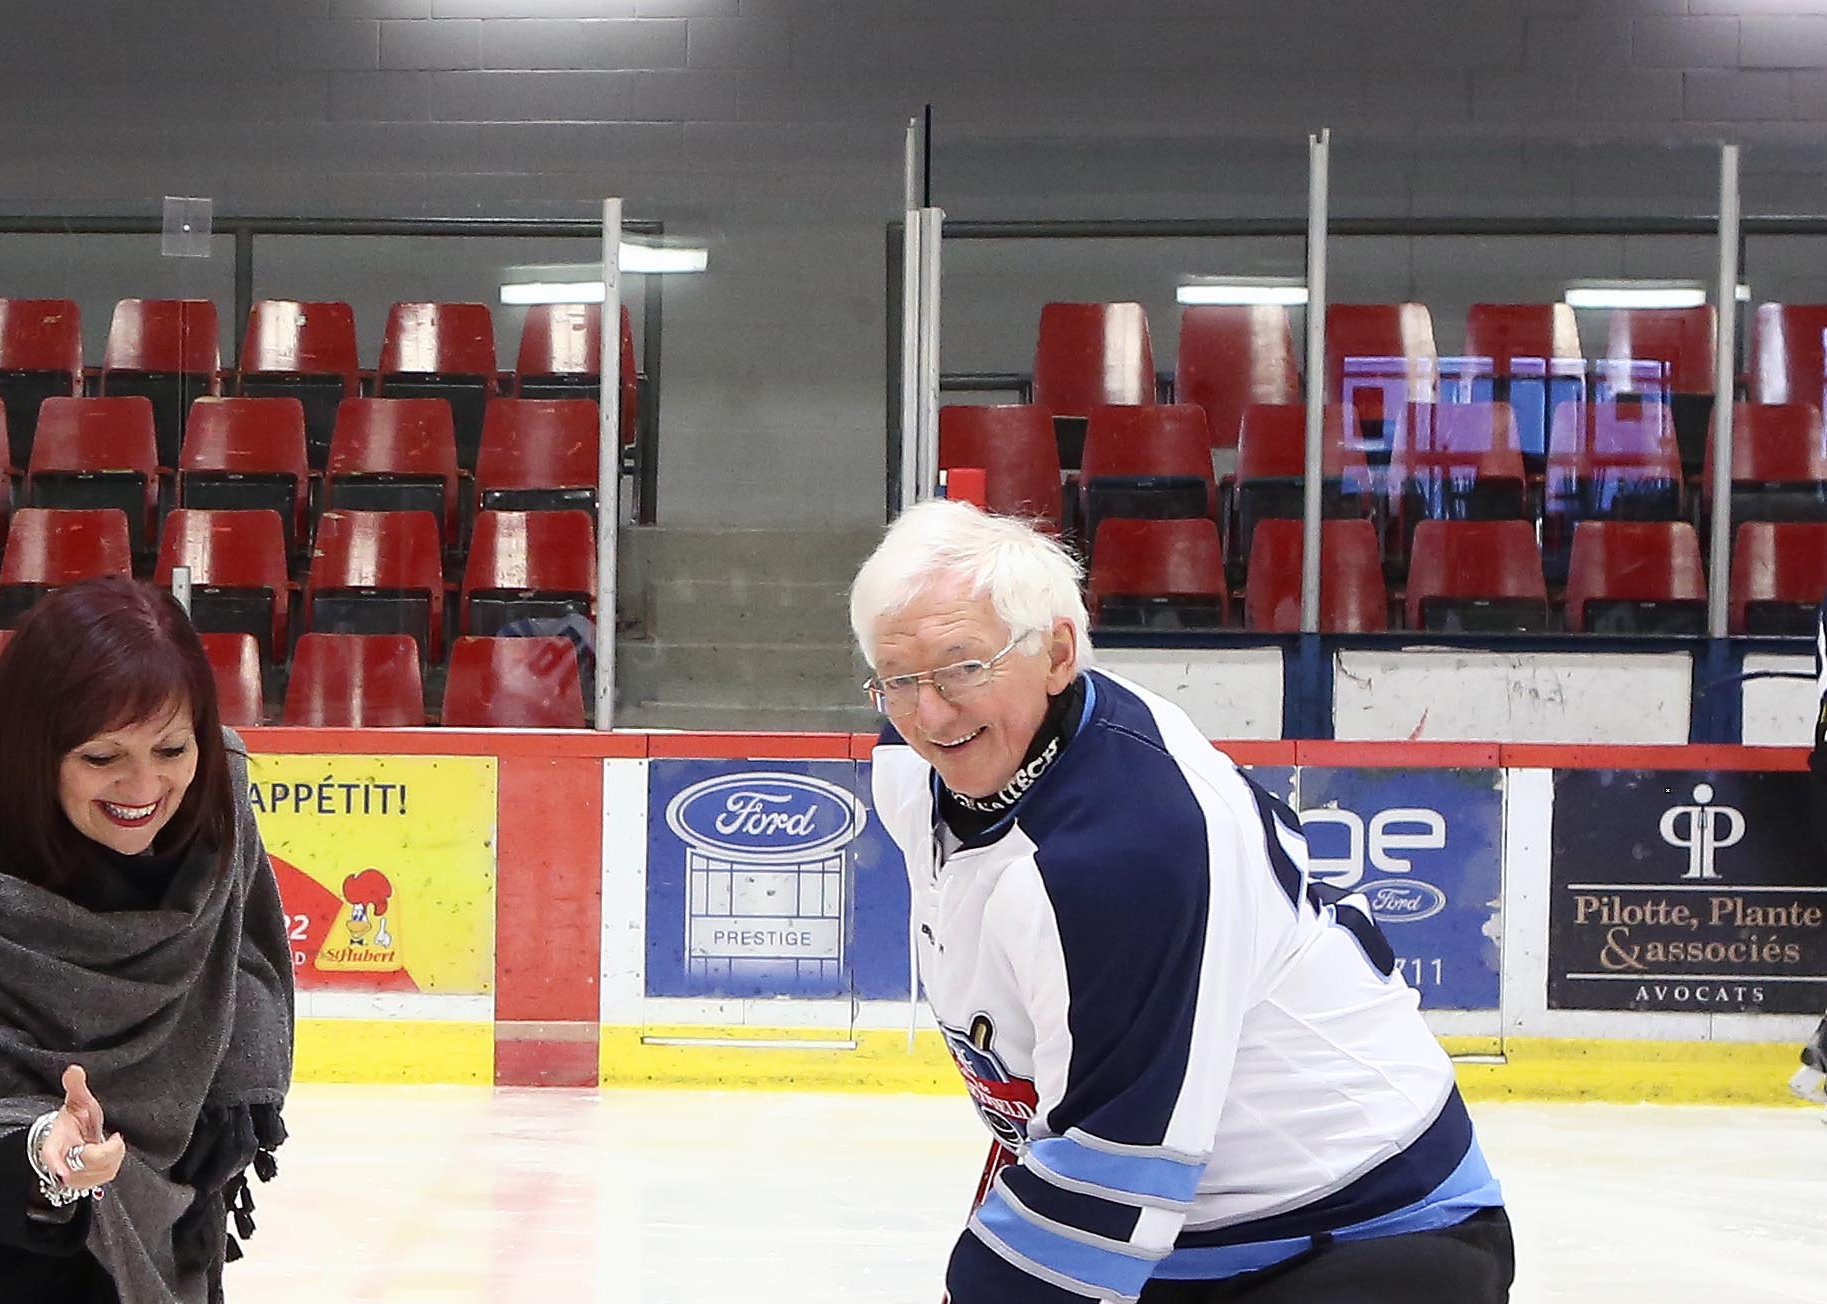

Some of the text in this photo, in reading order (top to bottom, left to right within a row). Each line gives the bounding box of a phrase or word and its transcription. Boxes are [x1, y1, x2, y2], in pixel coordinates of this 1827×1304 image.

[249, 775, 406, 815] APPÉTIT!
[715, 791, 819, 837] Ford
[1373, 888, 1422, 911] Ford
[1574, 895, 1822, 931] Pilotte, Plante
[714, 930, 812, 947] PRESTIGE
[1635, 986, 1766, 1001] AVOCATS
